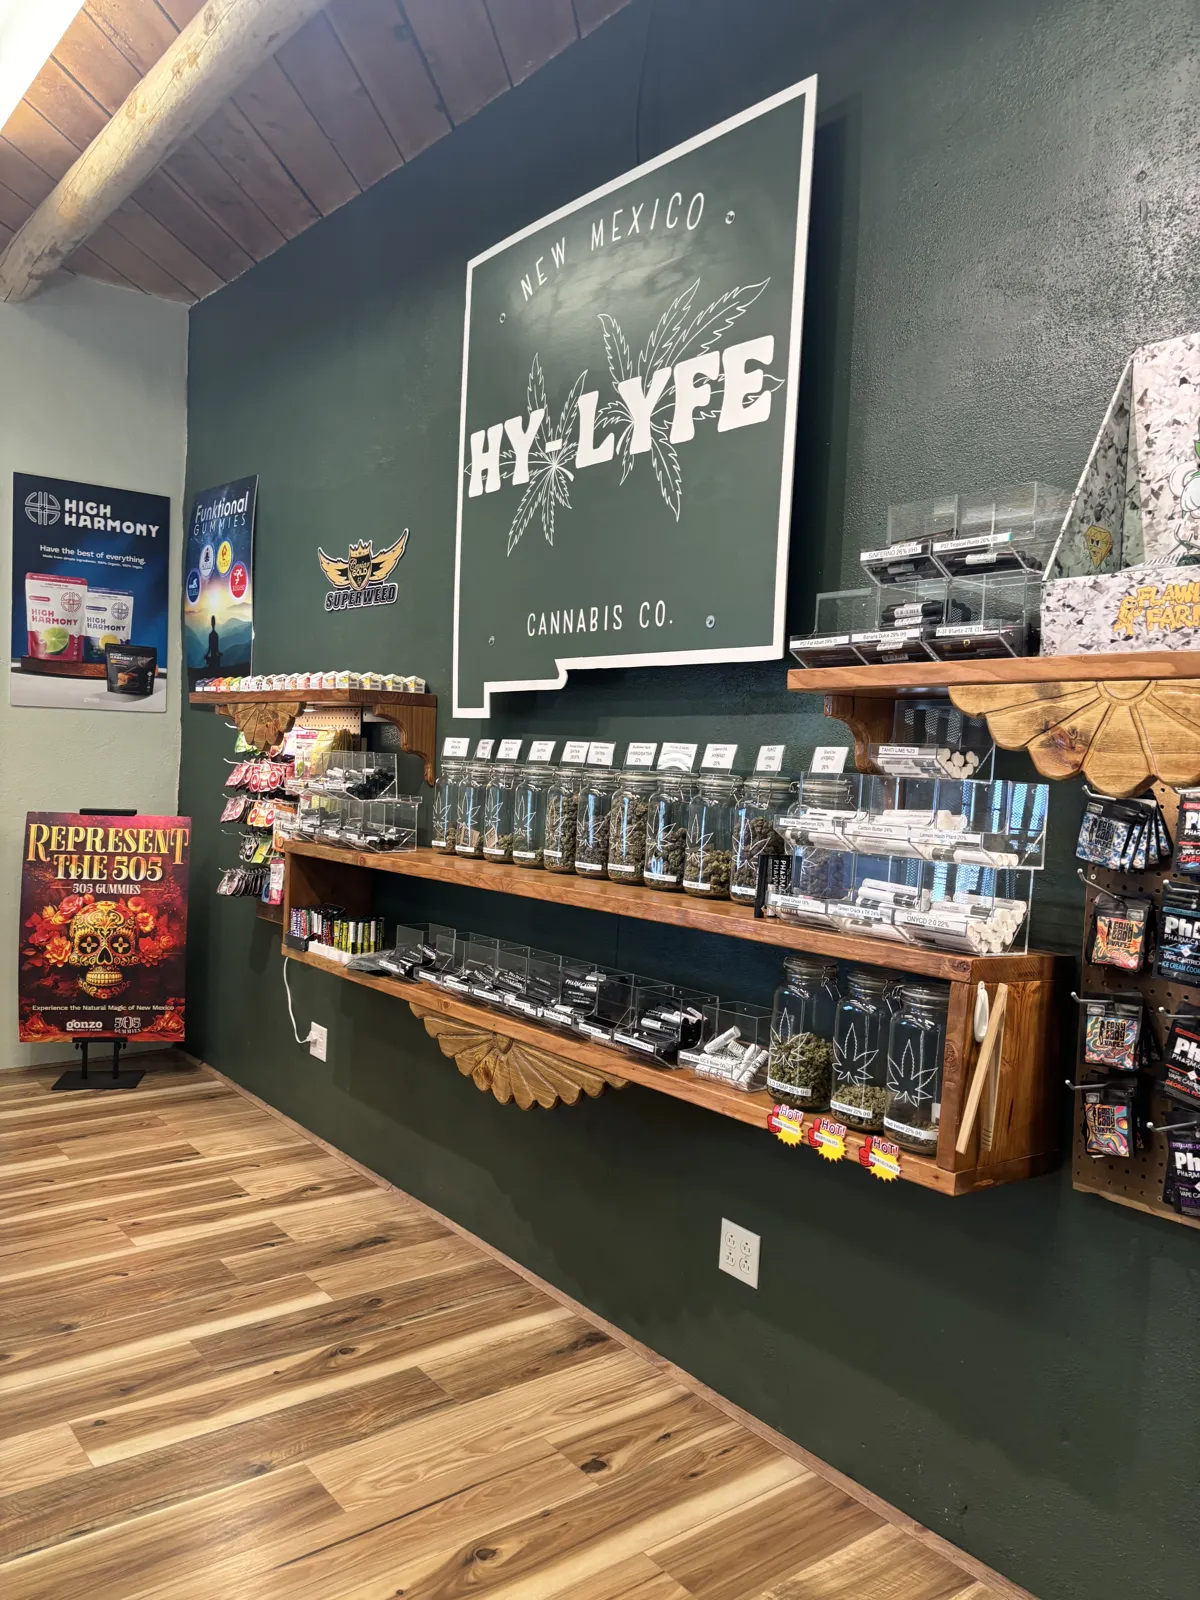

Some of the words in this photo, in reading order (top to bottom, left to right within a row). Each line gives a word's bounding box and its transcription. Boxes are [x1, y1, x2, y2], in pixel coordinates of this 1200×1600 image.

[520, 236, 566, 302] NEW
[591, 191, 705, 252] MEXICO
[468, 334, 775, 498] HY-LYFE
[64, 498, 111, 518] HIGH
[195, 490, 249, 524] Funktional
[64, 512, 160, 538] HARMONY
[193, 513, 246, 536] GUMMIES
[39, 544, 60, 554] Have
[61, 545, 75, 556] the
[76, 547, 94, 558] best
[96, 551, 104, 559] of
[352, 568, 368, 577] GOLD
[325, 584, 397, 610] SUPERWEED
[31, 608, 54, 617] HIGH
[31, 616, 78, 626] HARMONY
[86, 616, 106, 624] HIGH
[526, 604, 623, 637] CANNABIS
[638, 599, 673, 629] CO.
[86, 623, 126, 632] HARMONY
[26, 823, 189, 865] REPRESENT
[53, 854, 108, 881] THE
[111, 855, 164, 882] 505
[72, 884, 94, 894] 505
[96, 884, 141, 896] GUMMIES
[1170, 962, 1186, 971] CREAM
[66, 1020, 103, 1031] gonzo
[114, 1016, 142, 1029] 505
[780, 1104, 803, 1122] HOT!
[821, 1118, 846, 1137] HOT!
[873, 1136, 899, 1156] HOT!
